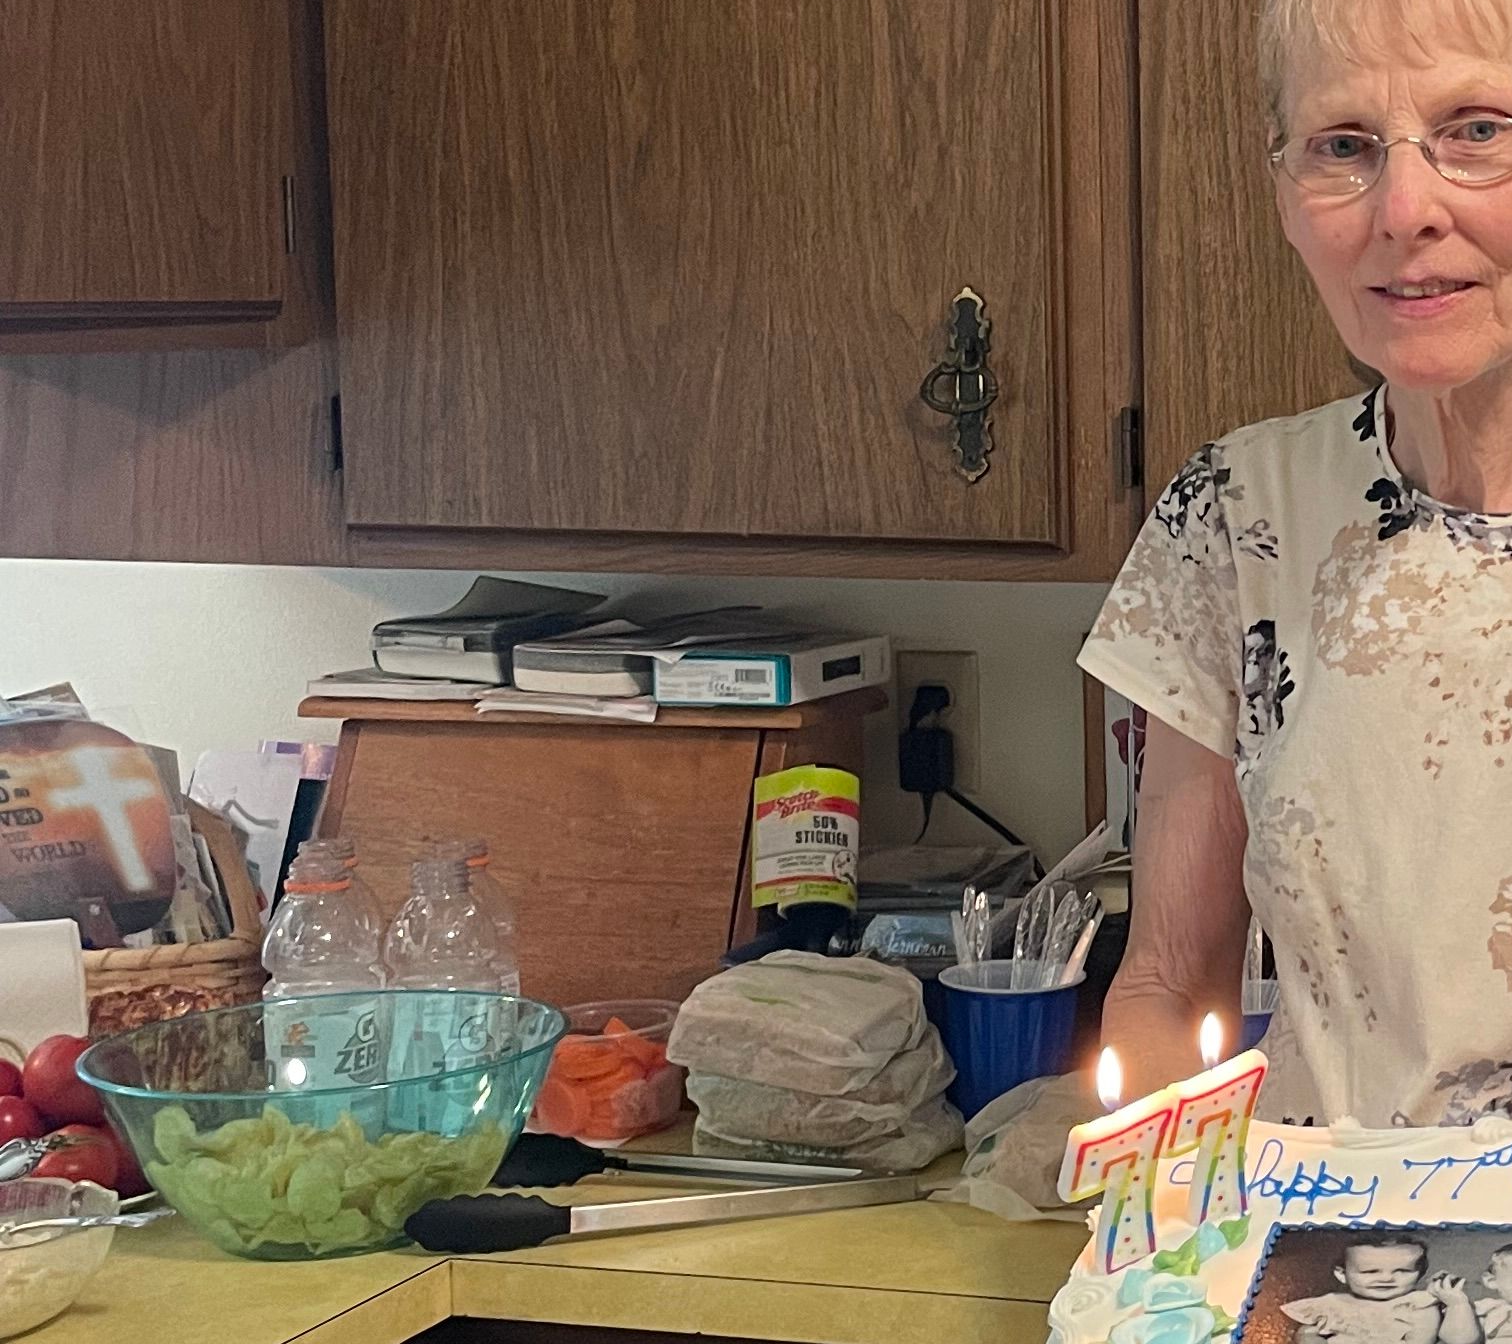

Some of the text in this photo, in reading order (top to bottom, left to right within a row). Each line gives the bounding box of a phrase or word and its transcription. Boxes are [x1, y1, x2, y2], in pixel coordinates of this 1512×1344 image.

[813, 815, 839, 830] 50%
[795, 830, 849, 847] STICKIER
[10, 840, 87, 864] WORLD
